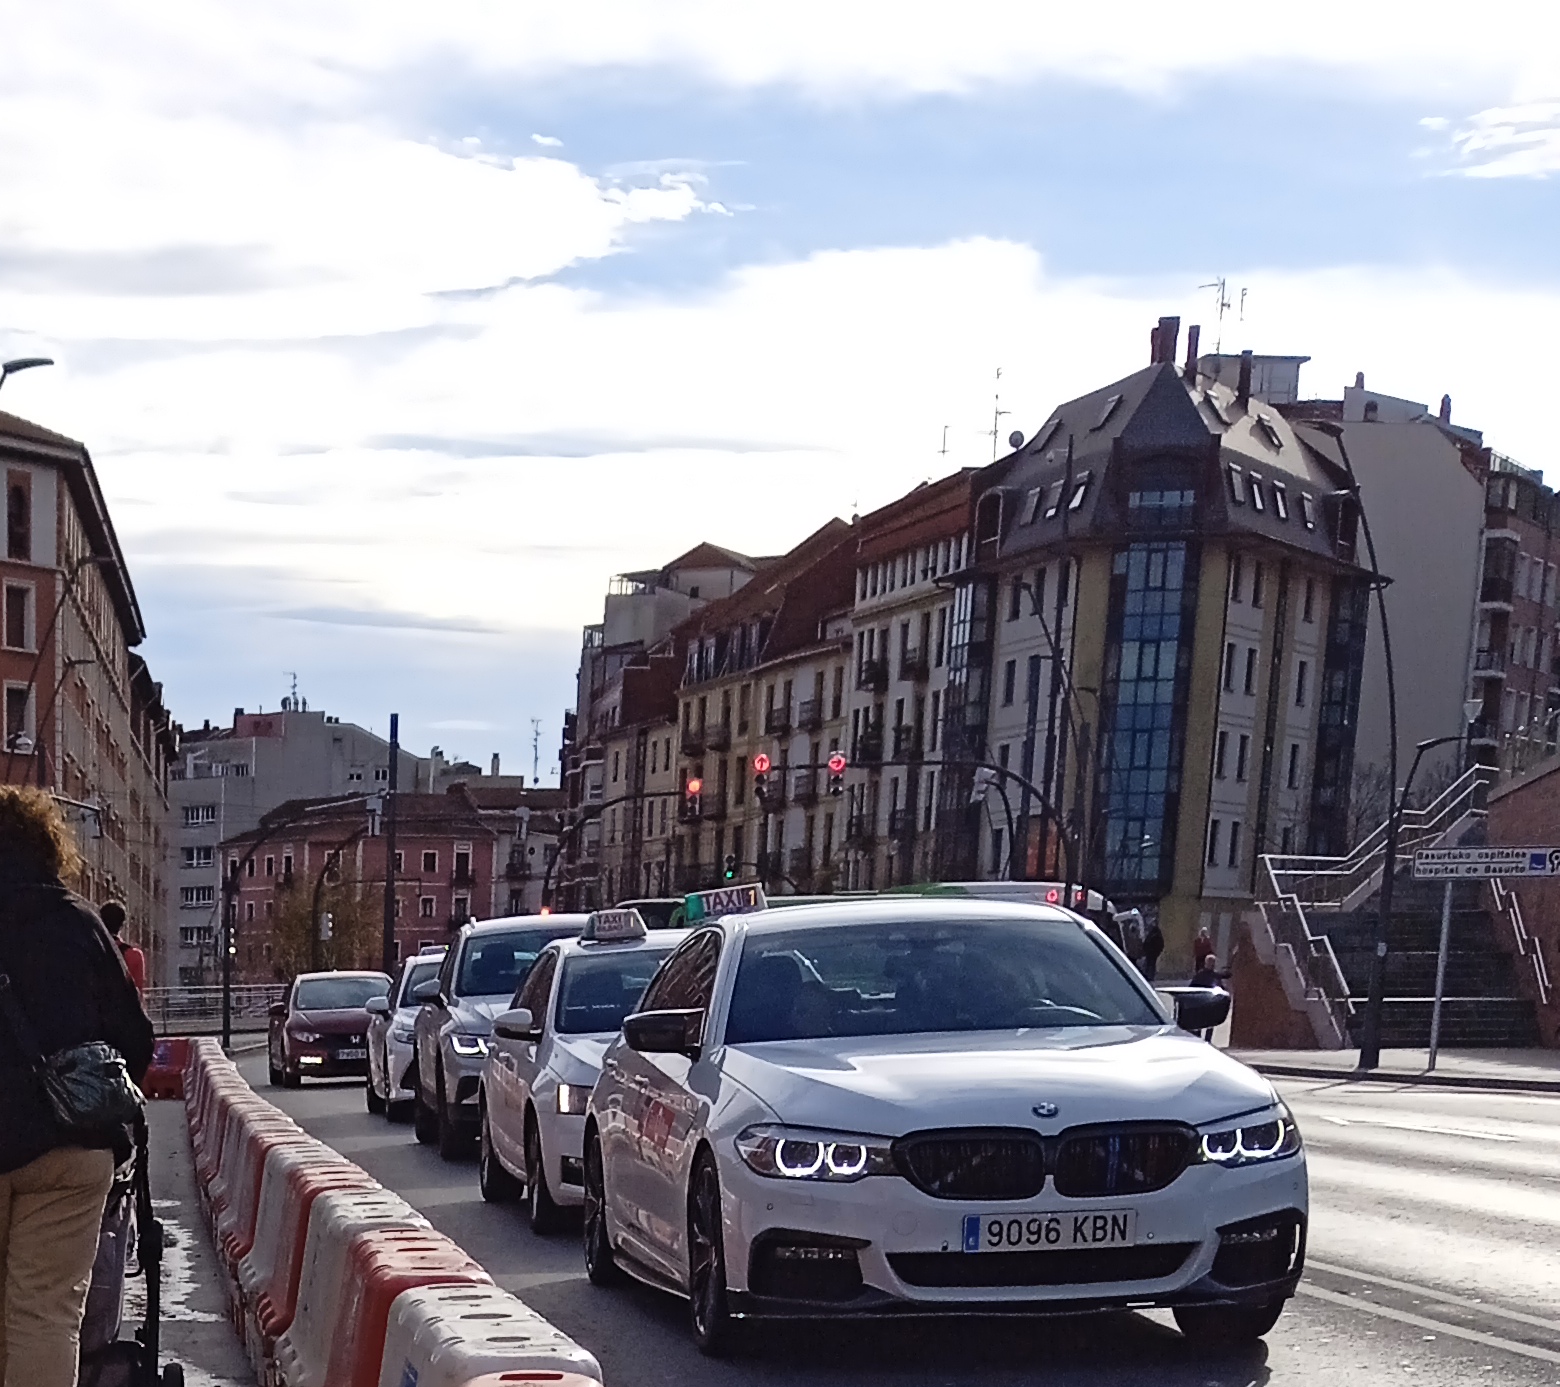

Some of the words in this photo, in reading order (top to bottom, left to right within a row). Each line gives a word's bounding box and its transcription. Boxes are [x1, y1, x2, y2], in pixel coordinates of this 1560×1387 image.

[1415, 866, 1459, 875] hospital
[1465, 865, 1479, 874] de
[1484, 864, 1526, 874] Basurto
[704, 888, 743, 911] TAXI
[748, 889, 756, 906] 1
[987, 1217, 1061, 1247] 9096
[1072, 1213, 1128, 1243] KBN
